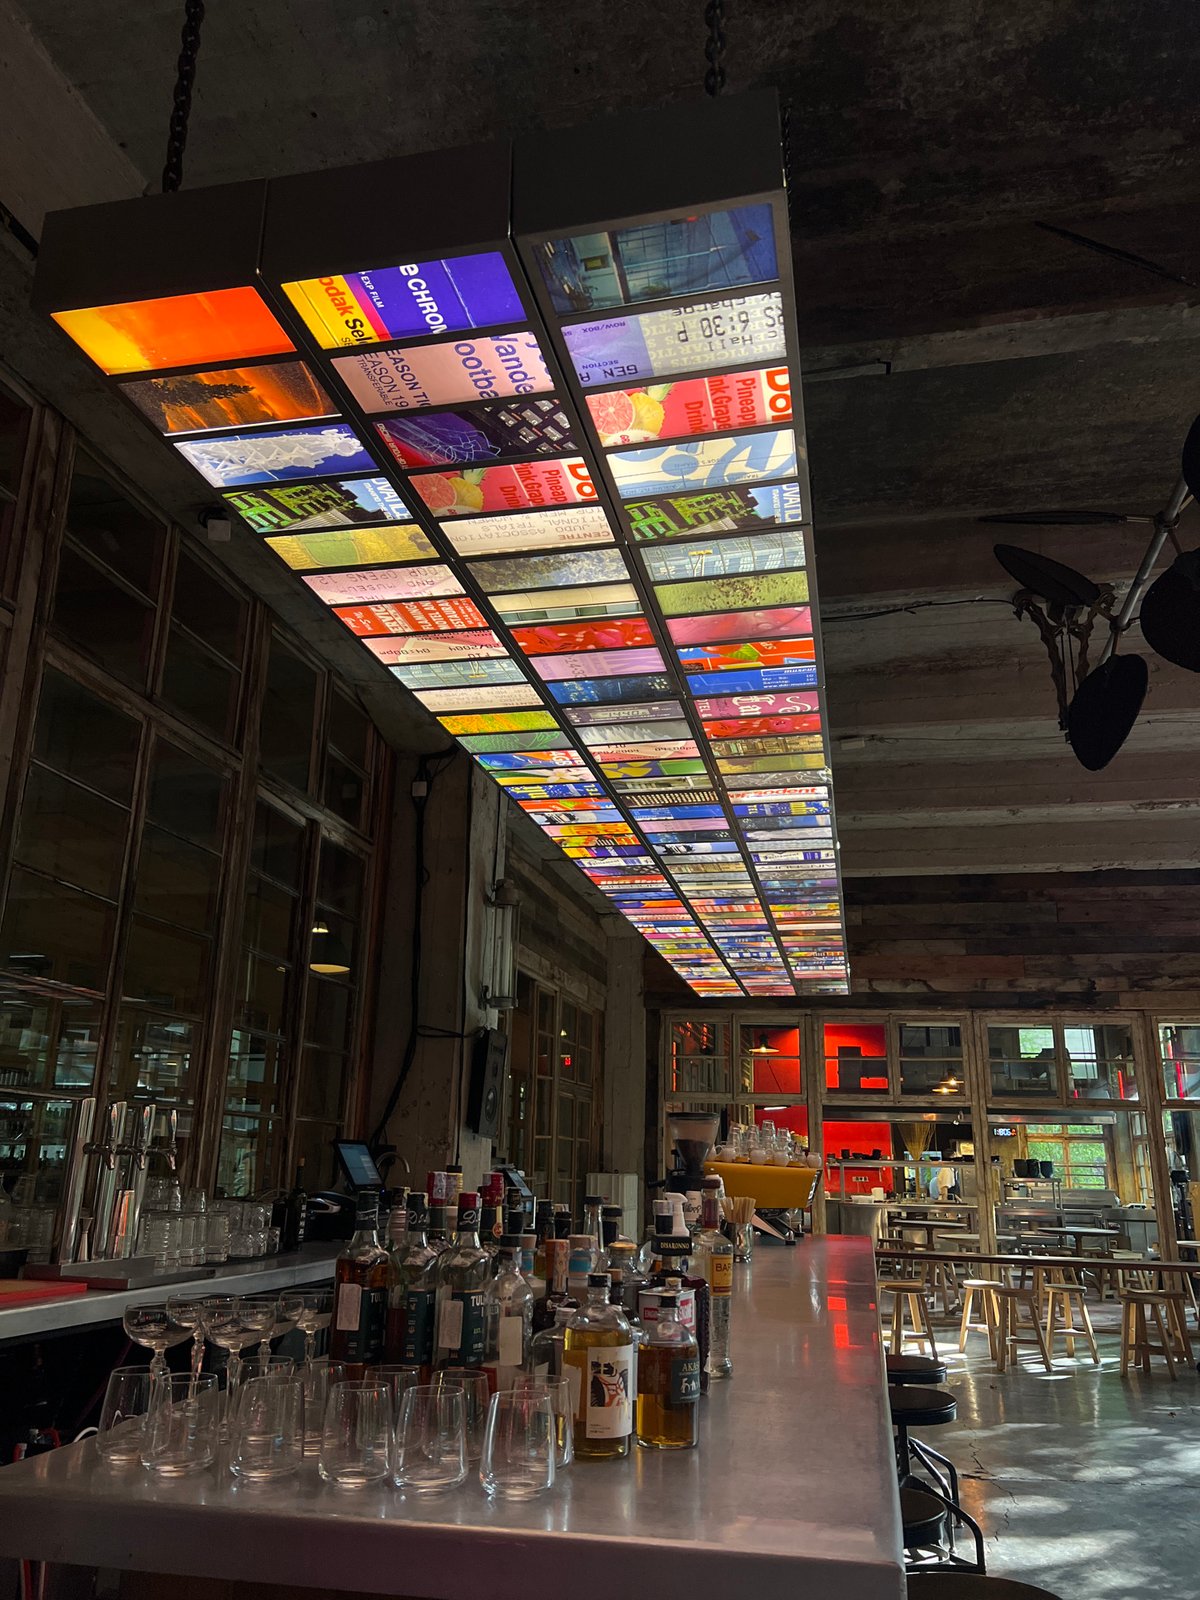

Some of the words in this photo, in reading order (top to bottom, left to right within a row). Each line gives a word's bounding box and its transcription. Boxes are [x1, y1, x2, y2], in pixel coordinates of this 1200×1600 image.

[360, 275, 376, 292] EXP
[369, 291, 385, 309] FILM
[580, 320, 627, 335] ROW/BOX
[698, 310, 751, 339] 6:30
[707, 334, 754, 351] Hall
[580, 358, 620, 370] SECTION
[601, 363, 639, 379] GEN
[355, 357, 394, 406] TRANSFERABLE
[479, 520, 536, 533] TRIALS
[553, 523, 591, 533] JUDO
[449, 526, 547, 544] ASSOCIATION
[557, 529, 611, 542] CENTRE
